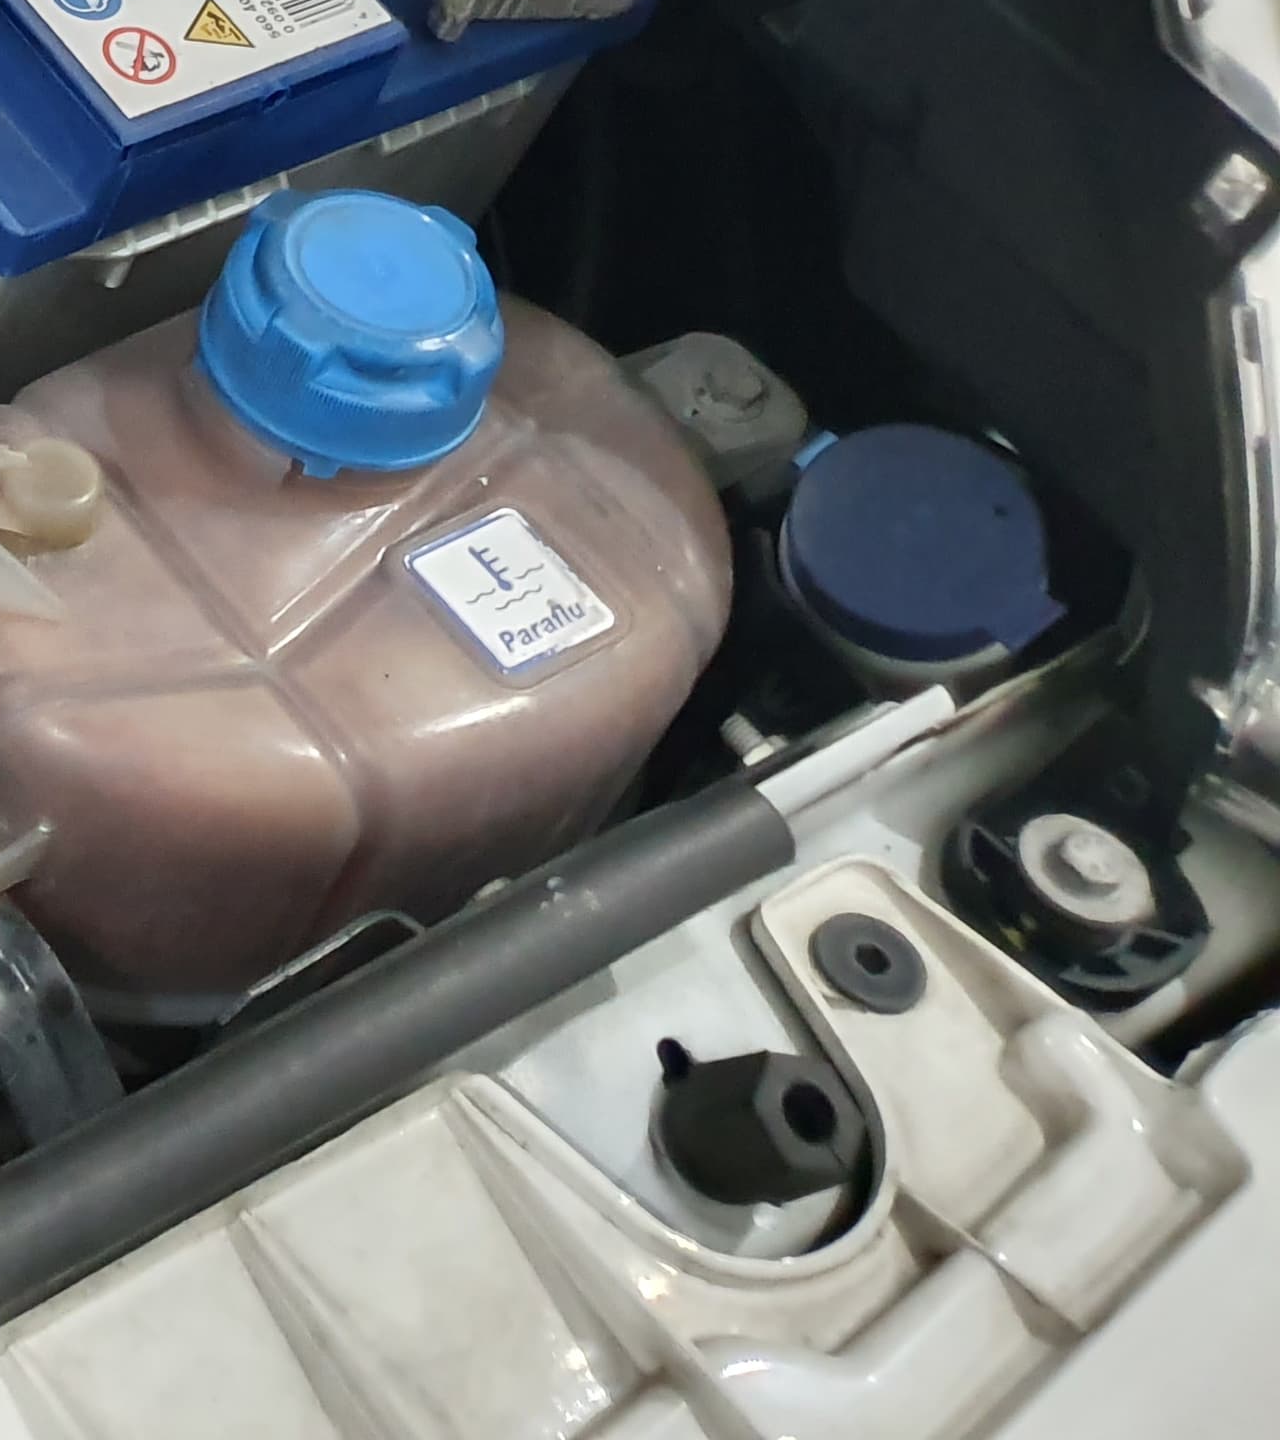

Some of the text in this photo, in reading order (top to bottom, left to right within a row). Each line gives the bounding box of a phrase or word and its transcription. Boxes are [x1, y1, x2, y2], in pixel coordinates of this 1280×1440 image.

[260, 0, 285, 24] 092
[255, 14, 282, 40] 560
[283, 24, 296, 34] 0
[498, 600, 586, 653] Paraflu
